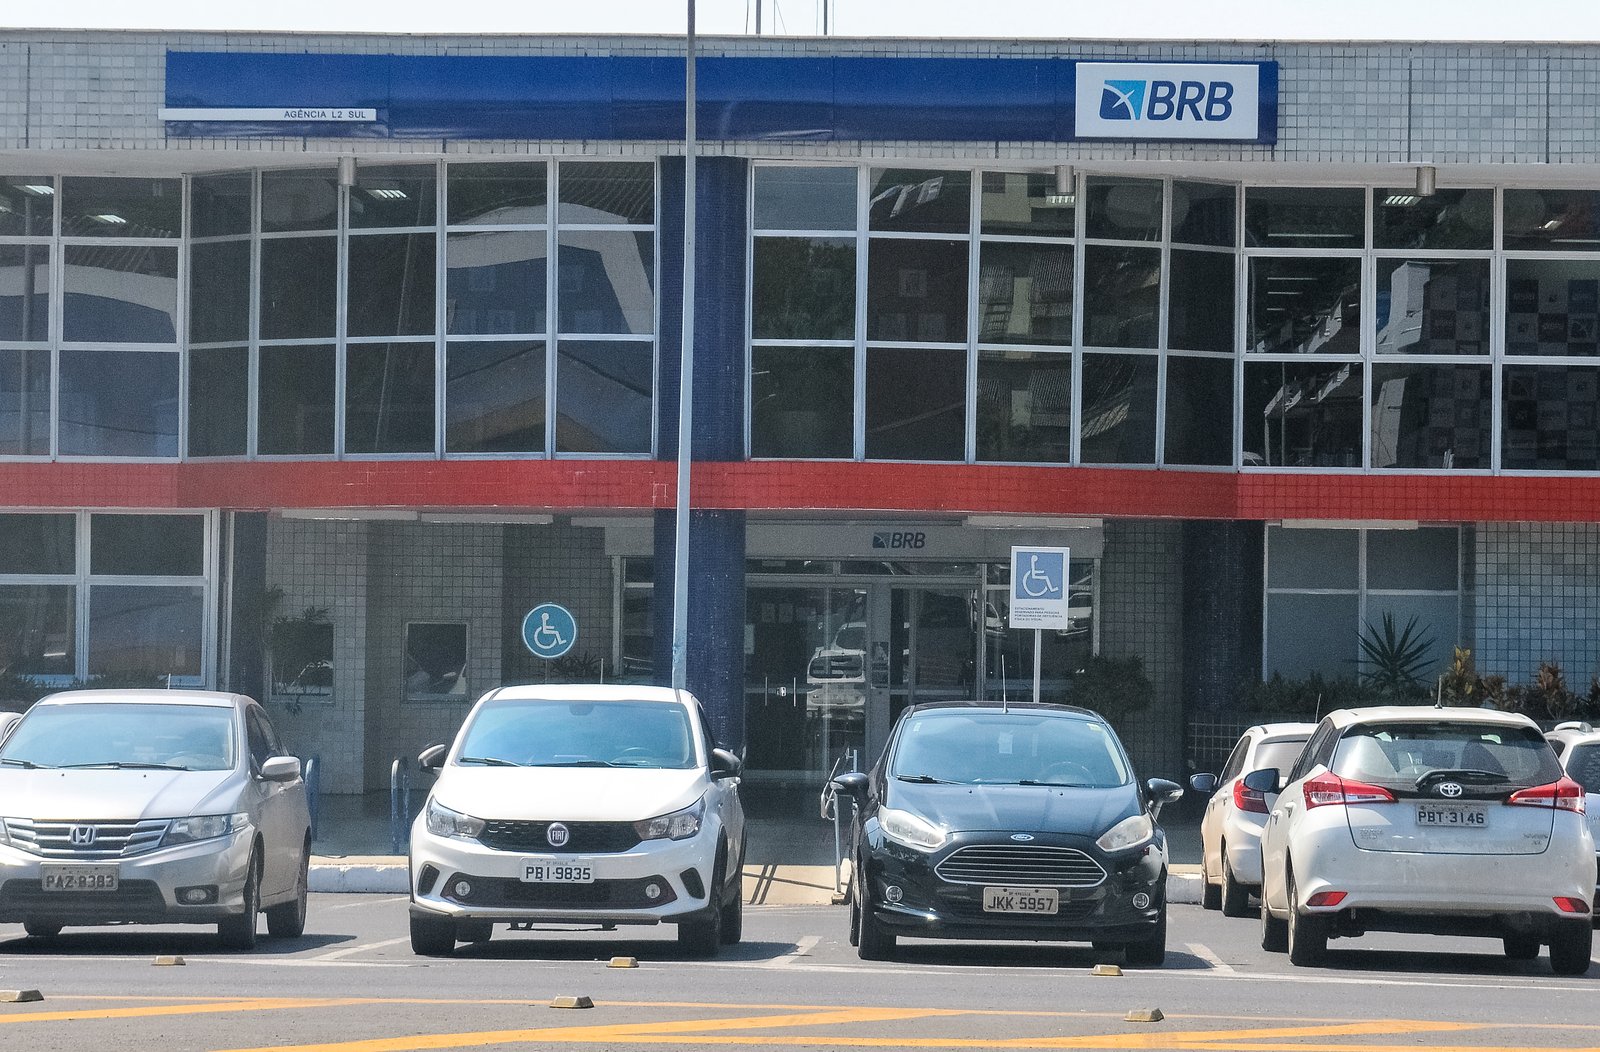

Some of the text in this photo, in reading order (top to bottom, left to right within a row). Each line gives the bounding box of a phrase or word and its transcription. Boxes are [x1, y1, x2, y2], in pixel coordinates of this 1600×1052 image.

[1147, 80, 1234, 121] BRB
[284, 109, 366, 119] AGÊNCIA L2 SUL
[891, 532, 926, 548] BRB
